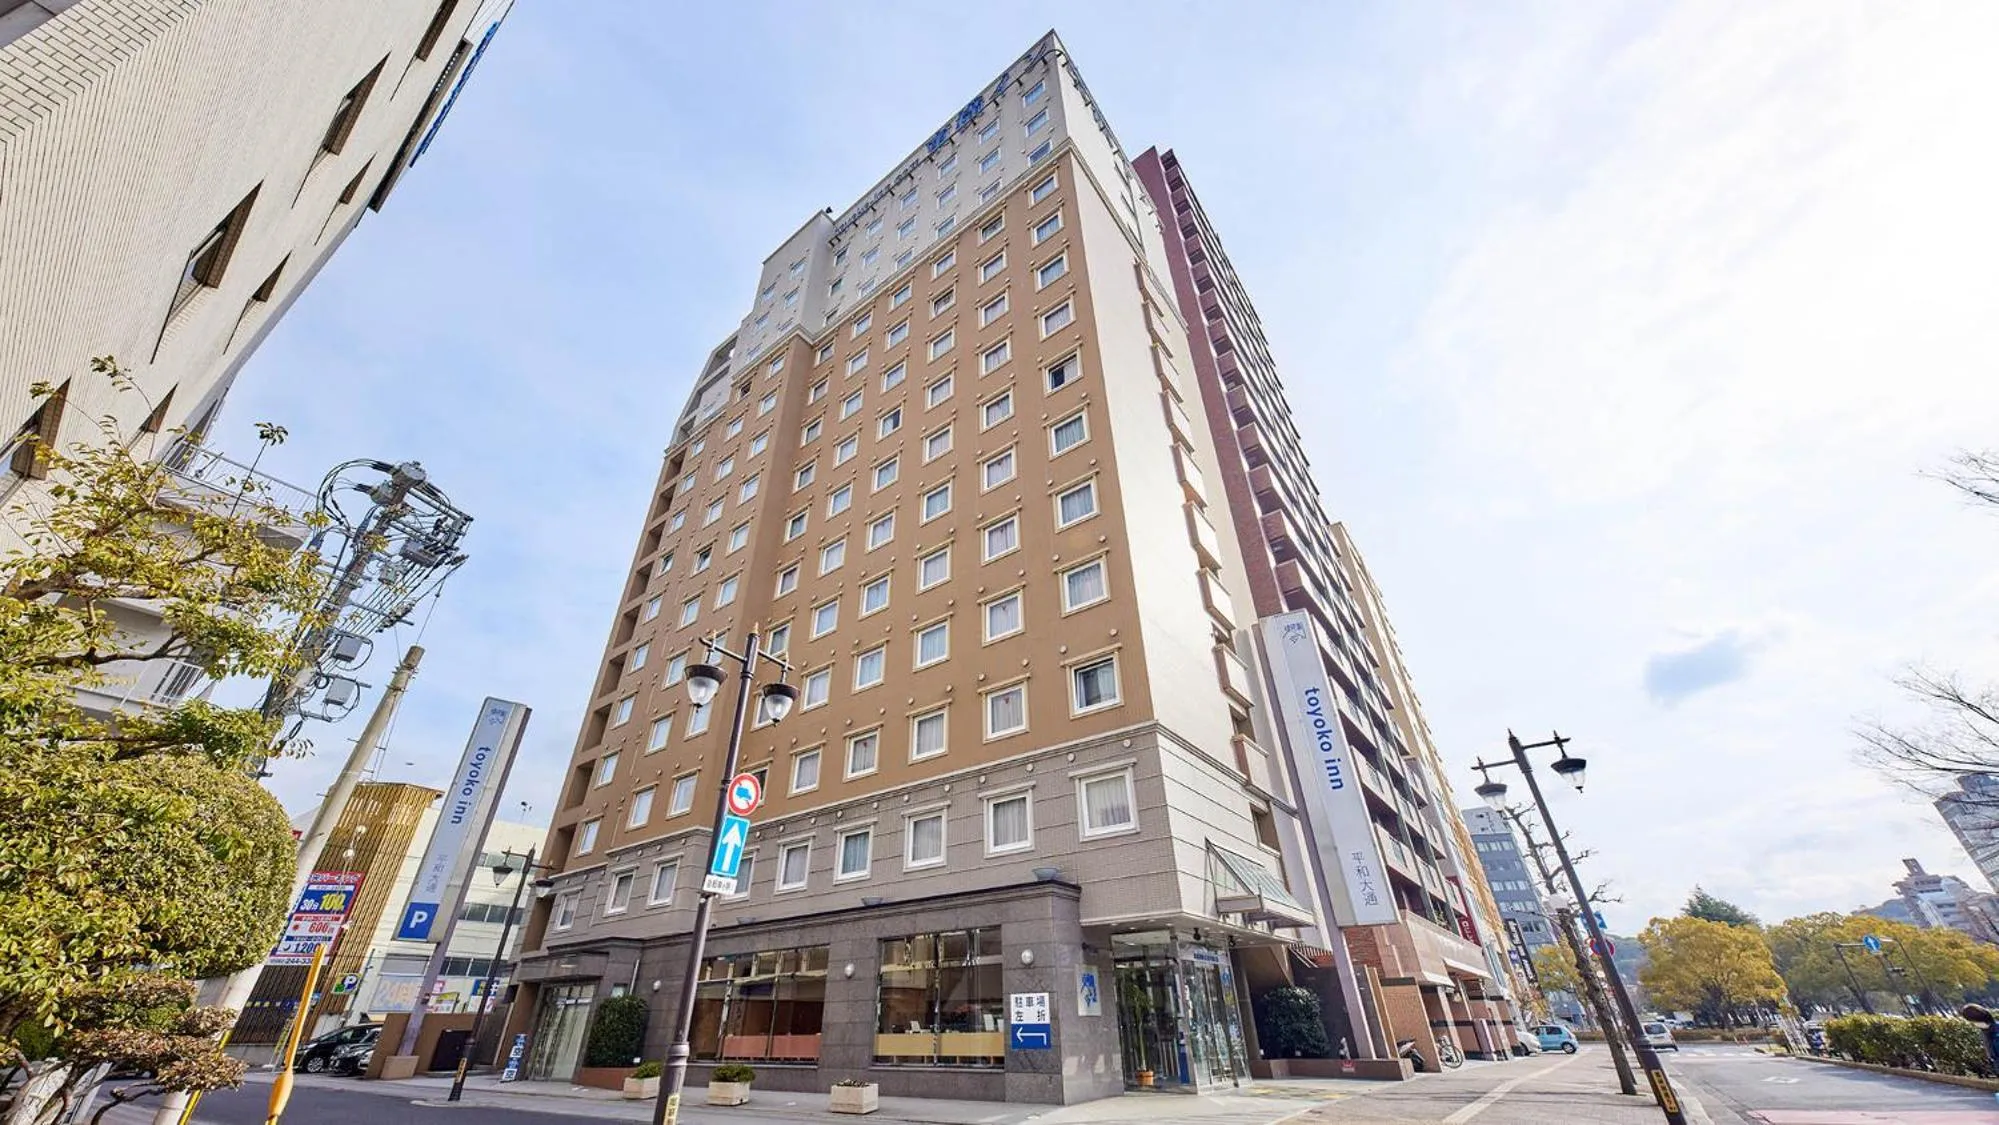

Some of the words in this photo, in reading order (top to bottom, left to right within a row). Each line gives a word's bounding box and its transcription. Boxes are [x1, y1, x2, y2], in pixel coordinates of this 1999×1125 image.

[1305, 686, 1333, 753] toyoko
[1324, 758, 1344, 790] inn
[462, 746, 491, 798] toyoko
[451, 801, 472, 825] inn
[1352, 852, 1379, 907] 平和大通
[410, 911, 428, 929] P
[1014, 996, 1046, 1009] 駐車場
